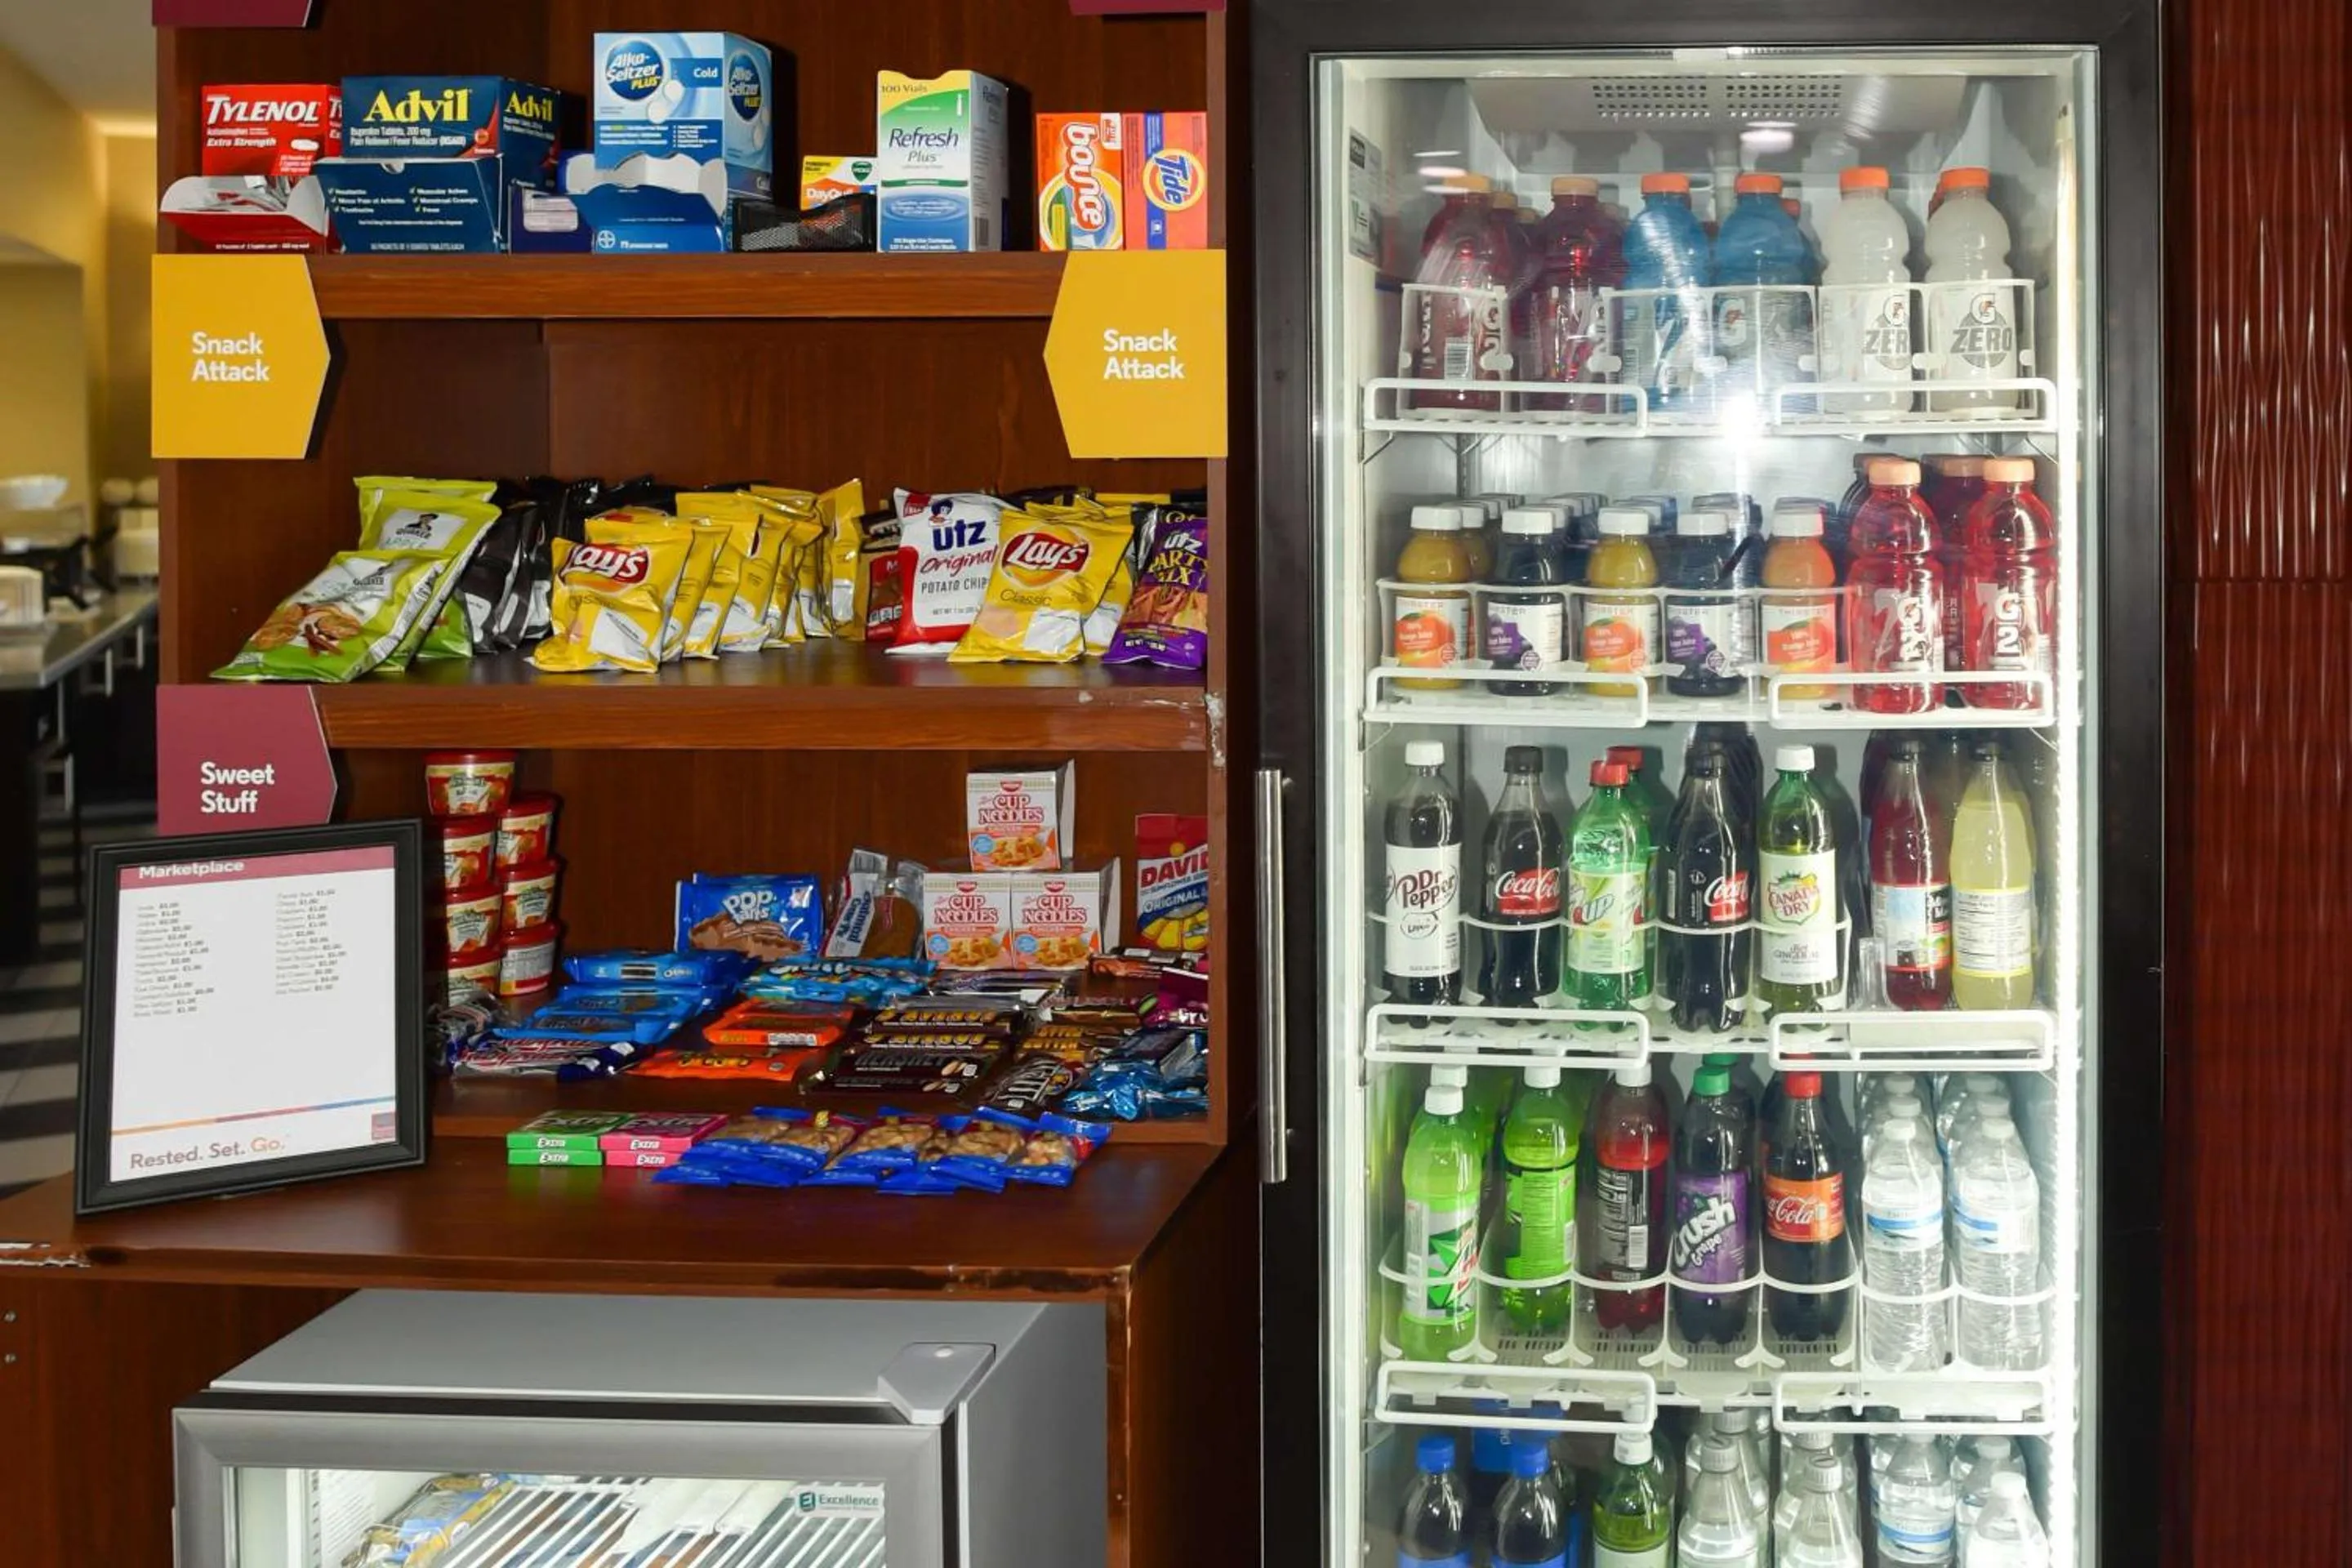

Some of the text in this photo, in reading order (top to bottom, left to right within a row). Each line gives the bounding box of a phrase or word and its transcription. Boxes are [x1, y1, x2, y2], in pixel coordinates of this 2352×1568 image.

[606, 64, 660, 82] Seltzer
[693, 67, 719, 78] Cold
[881, 84, 928, 93] 100 Vials
[206, 93, 321, 124] TYLENOL
[363, 87, 470, 122] Advil
[504, 90, 553, 122] Advil
[206, 136, 278, 149] Extra Strength
[889, 126, 960, 148] Refresh
[907, 149, 937, 163] Plus
[1064, 122, 1105, 229] bounce
[1152, 154, 1192, 204] Tide
[805, 187, 854, 204] DayQu
[191, 331, 264, 354] Snack
[1102, 327, 1178, 352] Snack
[1863, 327, 1909, 354] ZER
[1949, 327, 2013, 354] ZERO
[190, 359, 270, 382] Attack
[1103, 355, 1186, 380] Attack
[932, 519, 987, 551] utz
[560, 542, 649, 578] Lay's
[920, 543, 998, 577] Original
[1006, 535, 1087, 570] Lay's
[921, 579, 961, 594] POTATO
[1000, 589, 1053, 606] Classic
[200, 761, 275, 785] Sweet
[200, 790, 259, 813] Stuff
[993, 794, 1031, 809] CUP
[978, 807, 1045, 824] NOODLES
[138, 860, 245, 880] Marketplace
[1419, 869, 1442, 890] Dr
[948, 894, 986, 911] CUP
[1036, 894, 1075, 911] CUP
[1143, 887, 1200, 913] ORIGINAL
[1395, 874, 1456, 910] Pepper
[934, 907, 1000, 924] NOODLES
[1022, 907, 1087, 924] NOODLES
[1782, 901, 1811, 916] DRY
[129, 1135, 286, 1169] Rested. Set. Go.
[538, 1152, 569, 1164] Extra
[636, 1154, 666, 1165] Extra
[1690, 1233, 1723, 1267] Grape
[818, 1494, 880, 1506] Excellence
